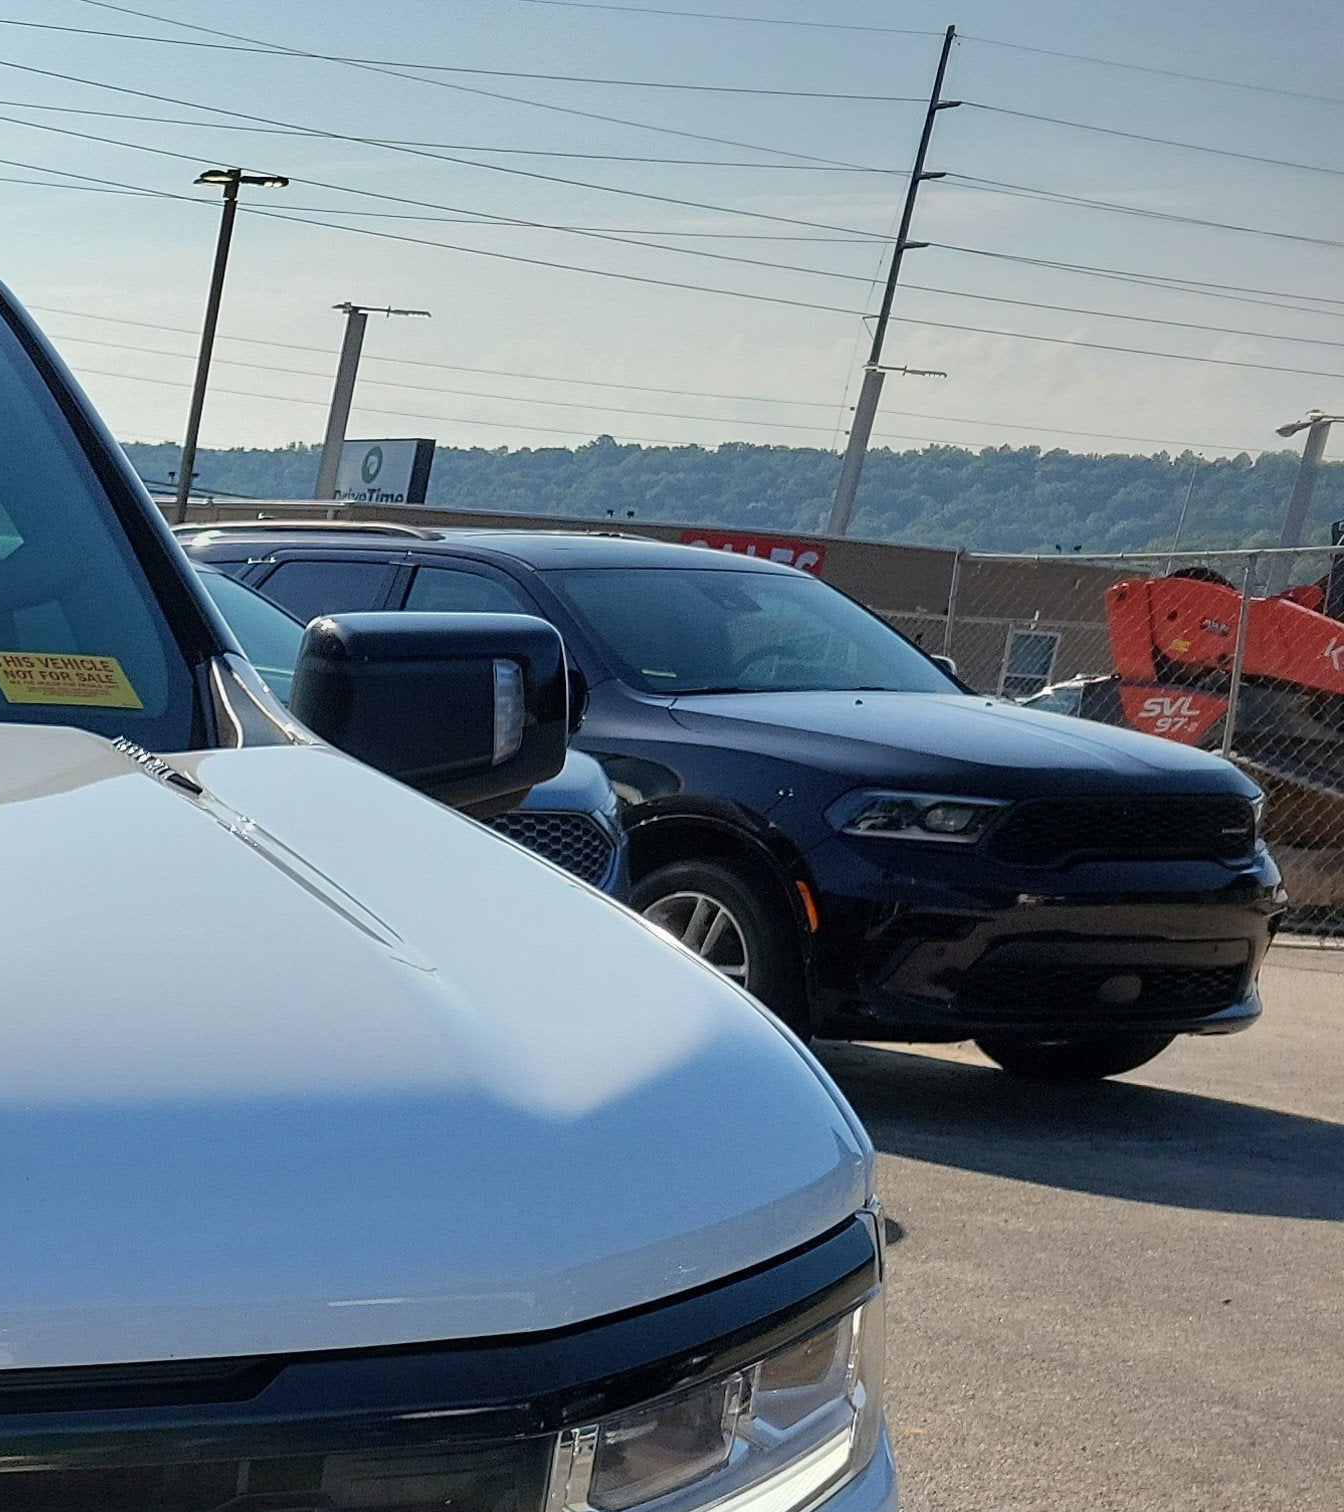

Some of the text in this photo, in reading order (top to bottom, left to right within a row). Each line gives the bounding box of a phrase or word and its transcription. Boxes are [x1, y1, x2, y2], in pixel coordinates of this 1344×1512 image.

[36, 656, 114, 673] VEHICLE
[3, 669, 117, 684] NOT FOR SALE
[1139, 697, 1200, 717] SVL
